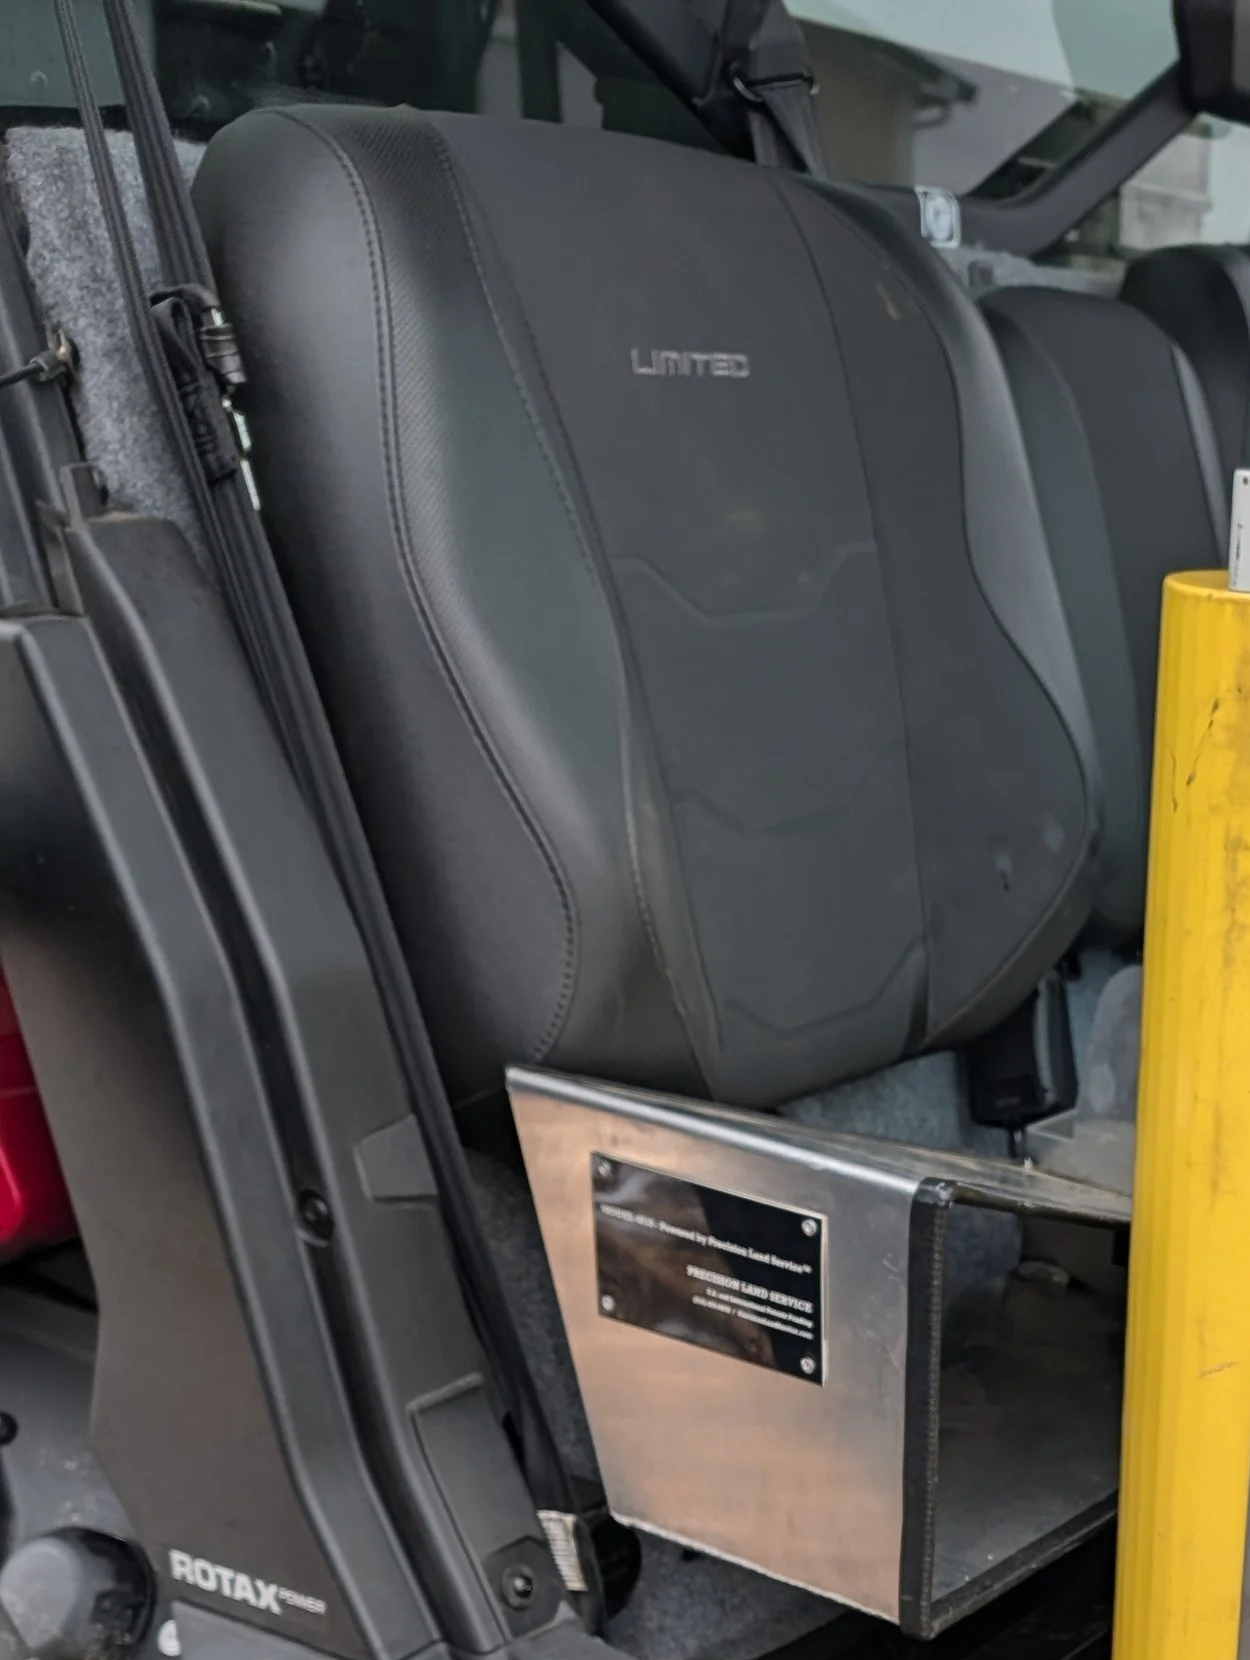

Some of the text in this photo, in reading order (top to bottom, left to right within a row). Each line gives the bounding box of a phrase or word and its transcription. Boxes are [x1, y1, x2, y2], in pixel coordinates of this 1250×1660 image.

[630, 348, 750, 378] LIMITED
[708, 1235, 747, 1256] Precision
[748, 1248, 769, 1263] Land
[686, 1264, 812, 1313] PRECISION LAND SERVICE
[169, 1548, 282, 1616] ROTAX
